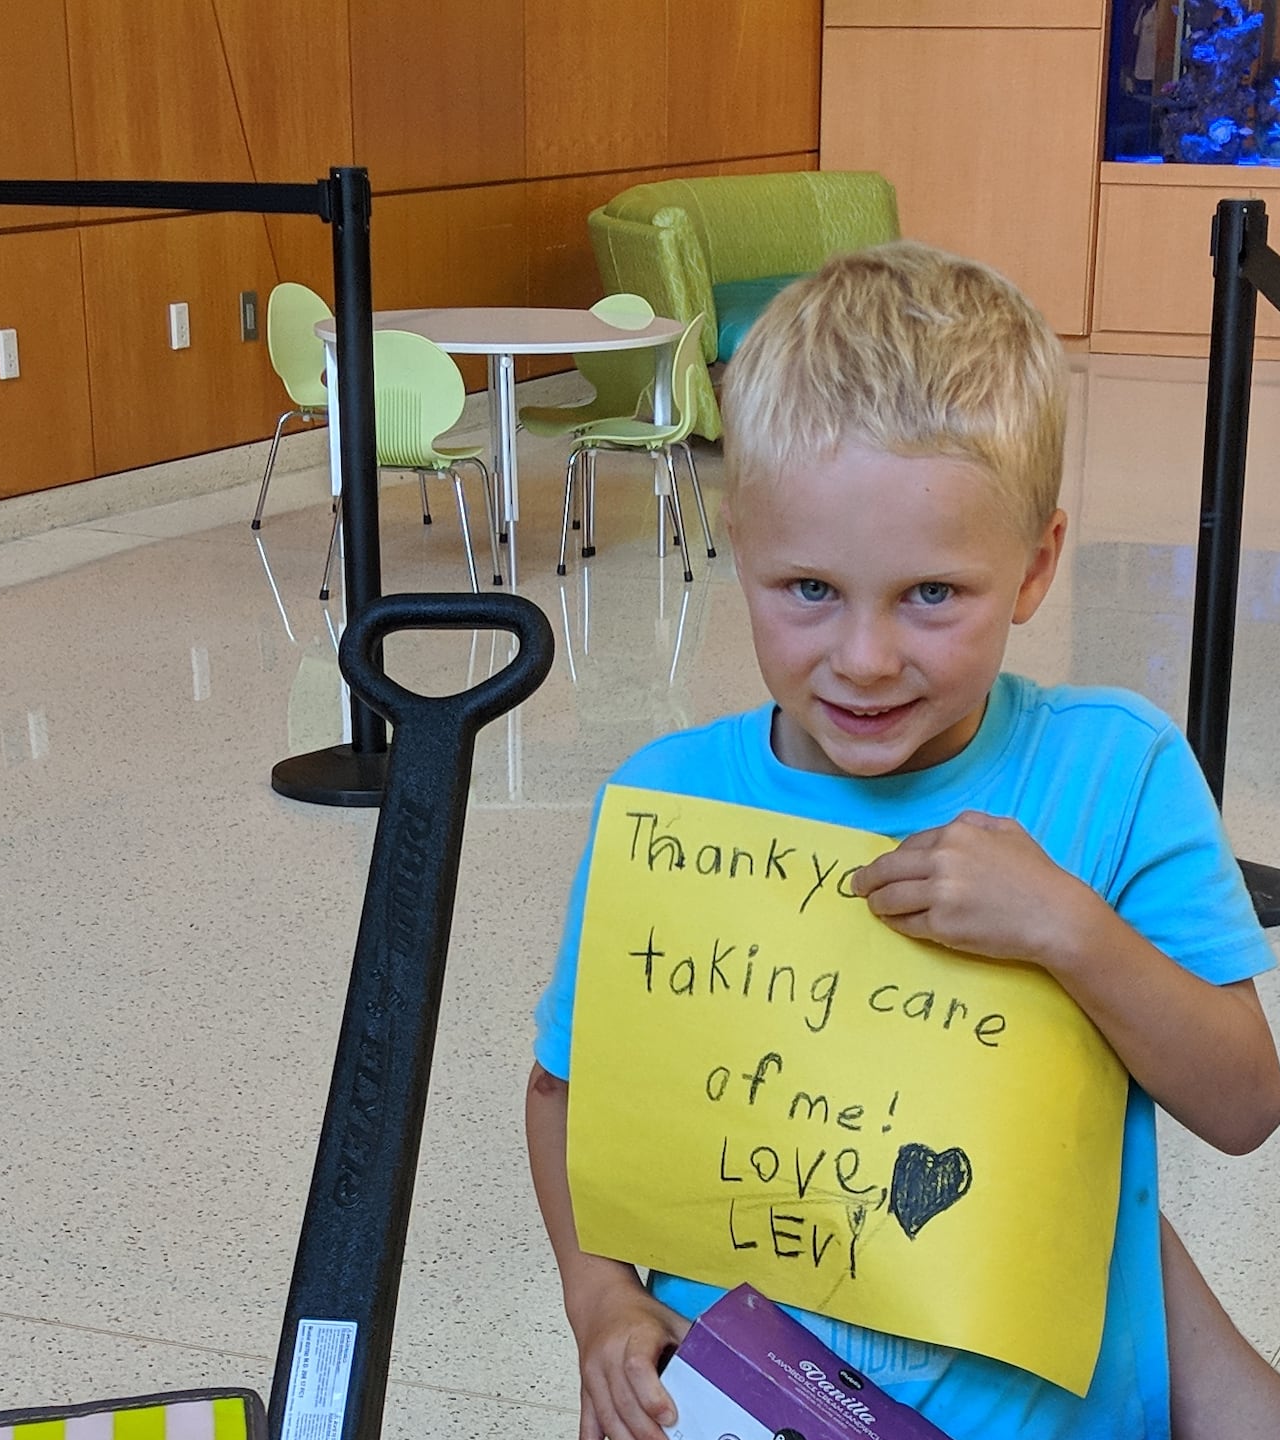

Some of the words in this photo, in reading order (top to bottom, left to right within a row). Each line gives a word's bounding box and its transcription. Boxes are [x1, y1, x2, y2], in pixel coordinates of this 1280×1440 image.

[626, 812, 797, 880] Thank
[628, 926, 839, 1032] taking
[869, 984, 1005, 1047] care
[705, 1051, 783, 1106] of
[787, 1090, 900, 1133] me!
[799, 1360, 878, 1427] Vanilla
[817, 1391, 844, 1414] CREAM
